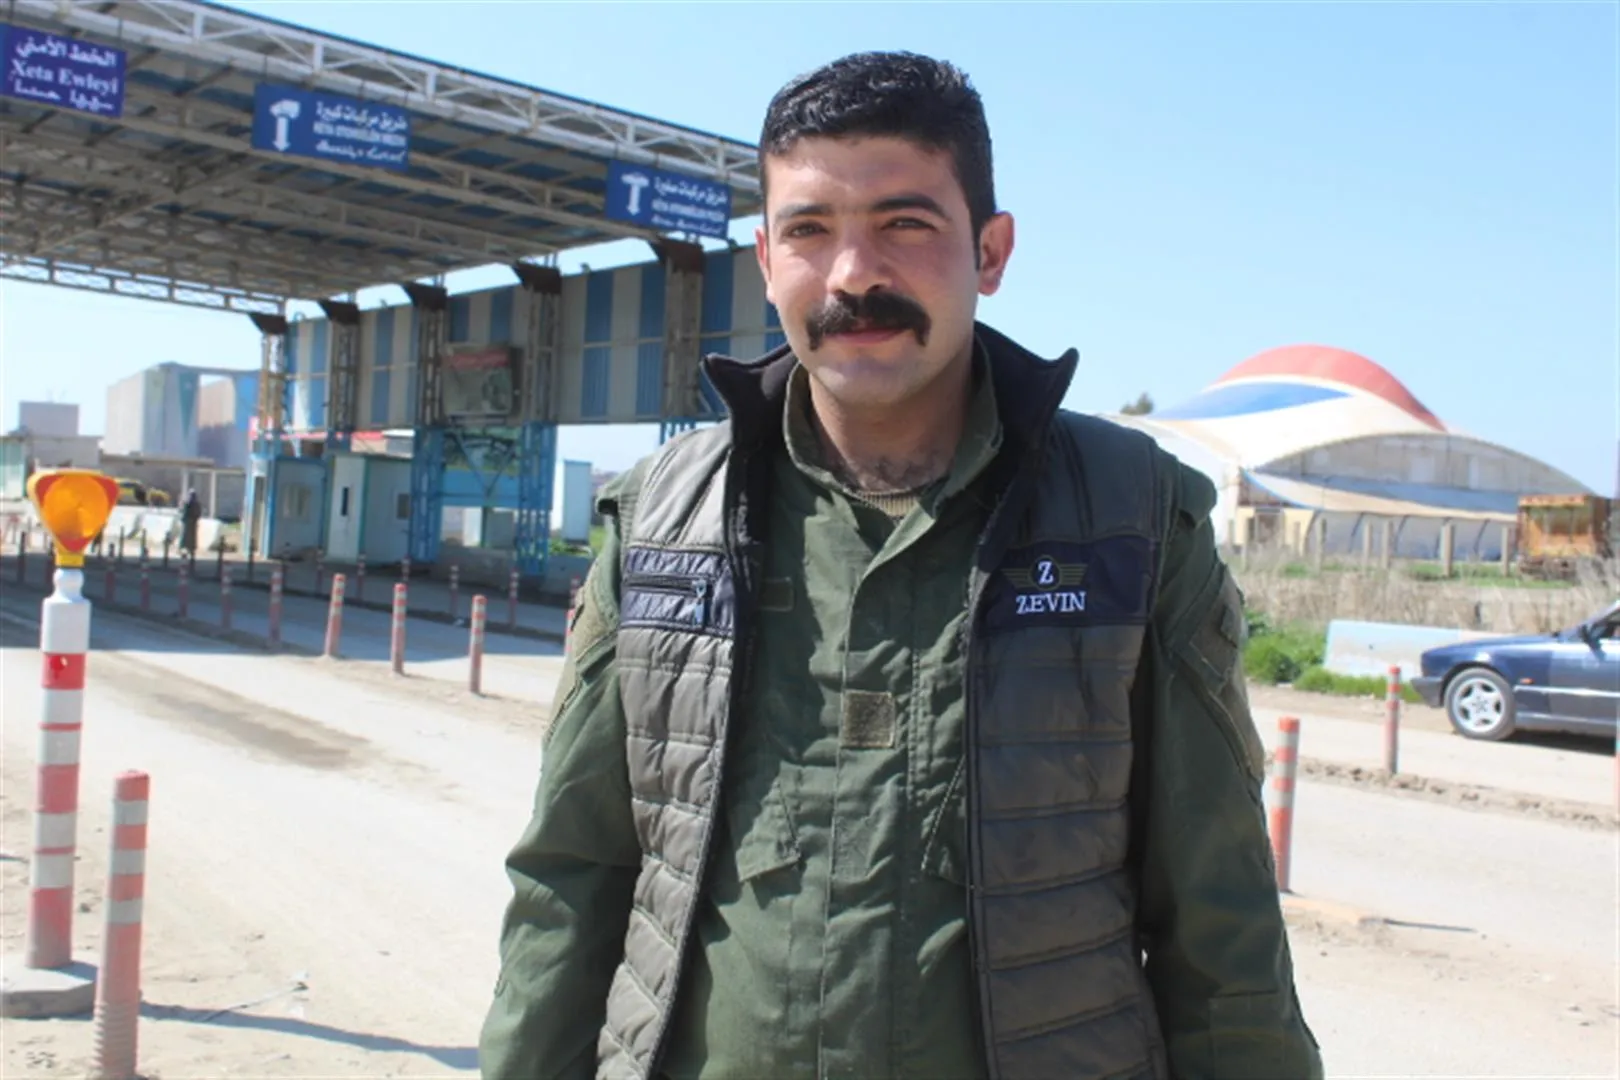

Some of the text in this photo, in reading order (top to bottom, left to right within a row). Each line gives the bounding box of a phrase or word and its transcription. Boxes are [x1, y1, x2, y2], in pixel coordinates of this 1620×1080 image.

[10, 58, 54, 82] Xeta
[1038, 561, 1054, 584] Z
[1016, 591, 1086, 615] ZEVIN
